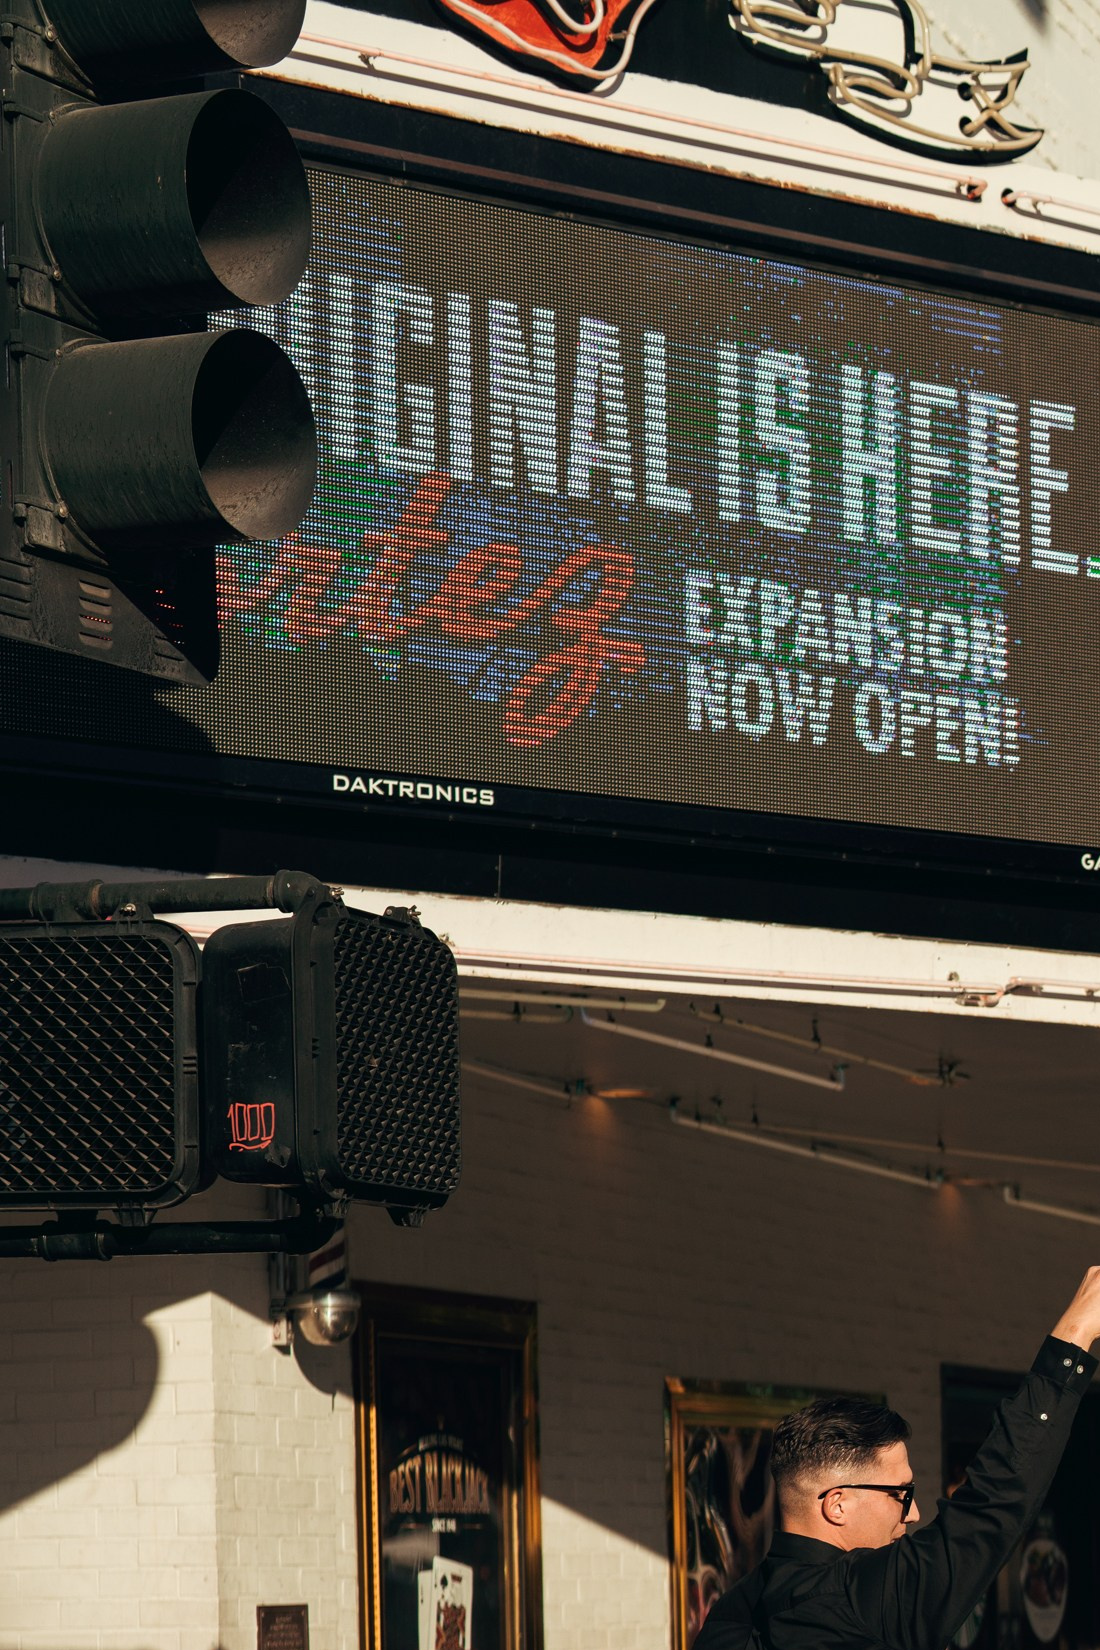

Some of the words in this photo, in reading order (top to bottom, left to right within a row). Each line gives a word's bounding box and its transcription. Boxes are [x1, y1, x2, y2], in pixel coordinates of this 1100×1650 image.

[207, 268, 694, 514] IGINAL
[717, 341, 812, 533] IS
[685, 568, 1009, 680] EXPANSION
[686, 658, 836, 745] NOW
[332, 773, 495, 806] DAKTRONICS
[389, 1454, 422, 1513] BEST
